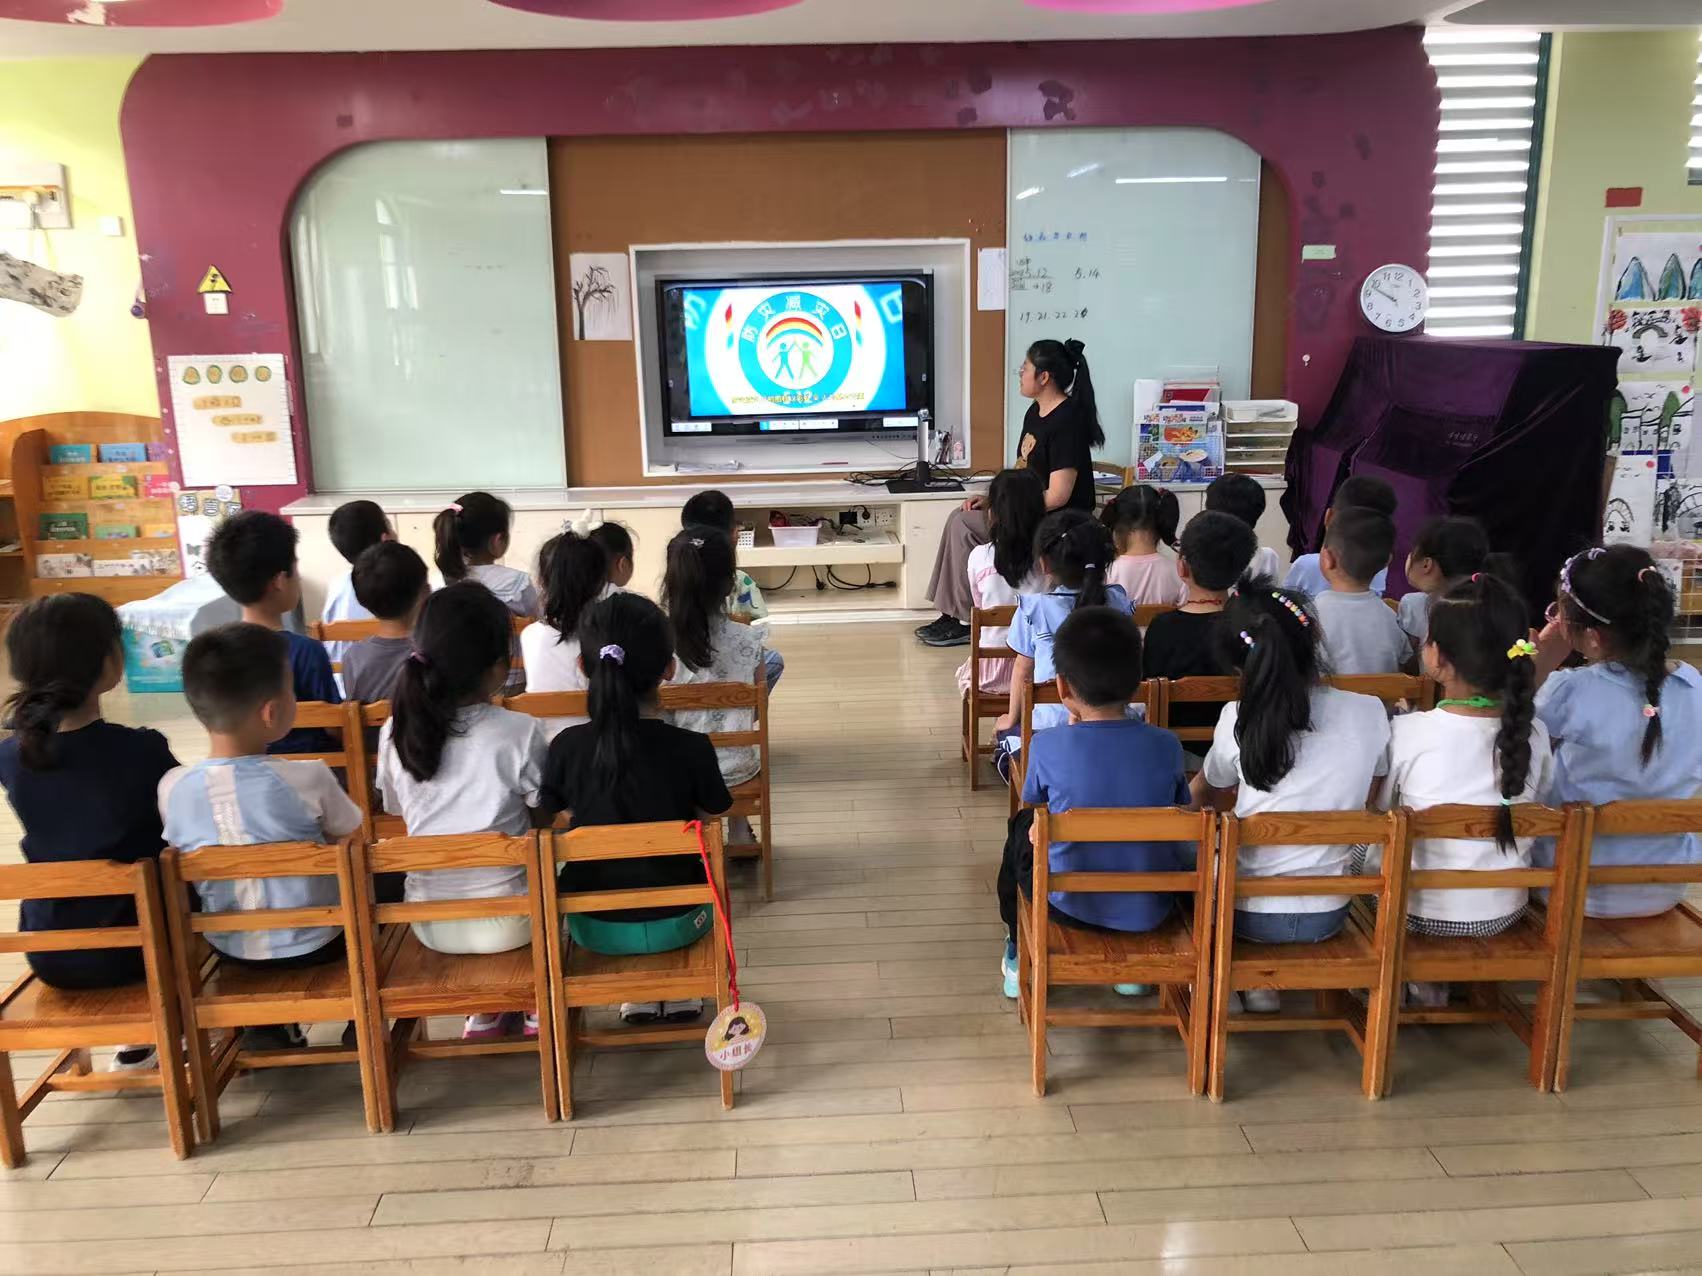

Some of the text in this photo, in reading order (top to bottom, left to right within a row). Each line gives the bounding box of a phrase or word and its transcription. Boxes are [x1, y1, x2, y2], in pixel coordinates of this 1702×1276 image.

[1383, 272, 1391, 280] 11
[1394, 272, 1404, 281] 12
[1414, 289, 1421, 297] 2
[1367, 302, 1373, 310] 8
[1416, 301, 1422, 310] 3
[1409, 312, 1415, 321] 4
[1385, 319, 1392, 328] 6
[1398, 319, 1404, 327] 5
[720, 1042, 752, 1060] 小组长
